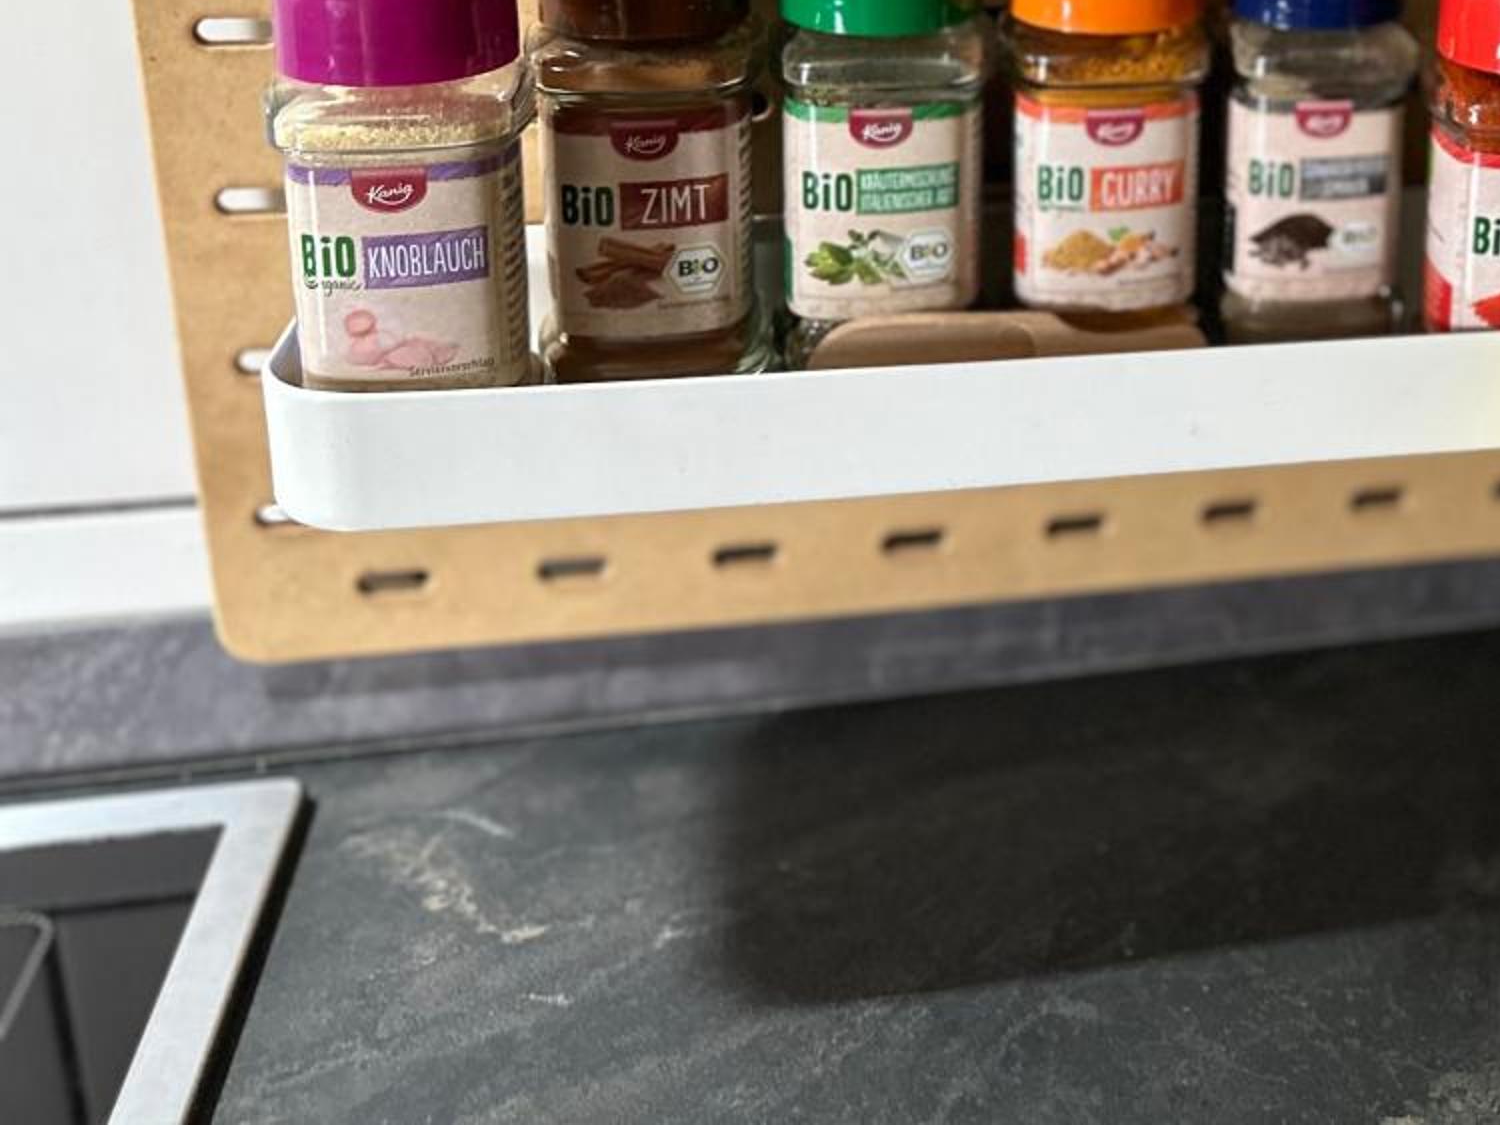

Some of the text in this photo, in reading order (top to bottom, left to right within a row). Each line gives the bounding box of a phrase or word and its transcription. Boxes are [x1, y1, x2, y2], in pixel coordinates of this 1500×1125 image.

[640, 184, 711, 224] ZIMT
[1102, 169, 1175, 207] CURRY
[367, 237, 486, 280] KNOBLAUCH
